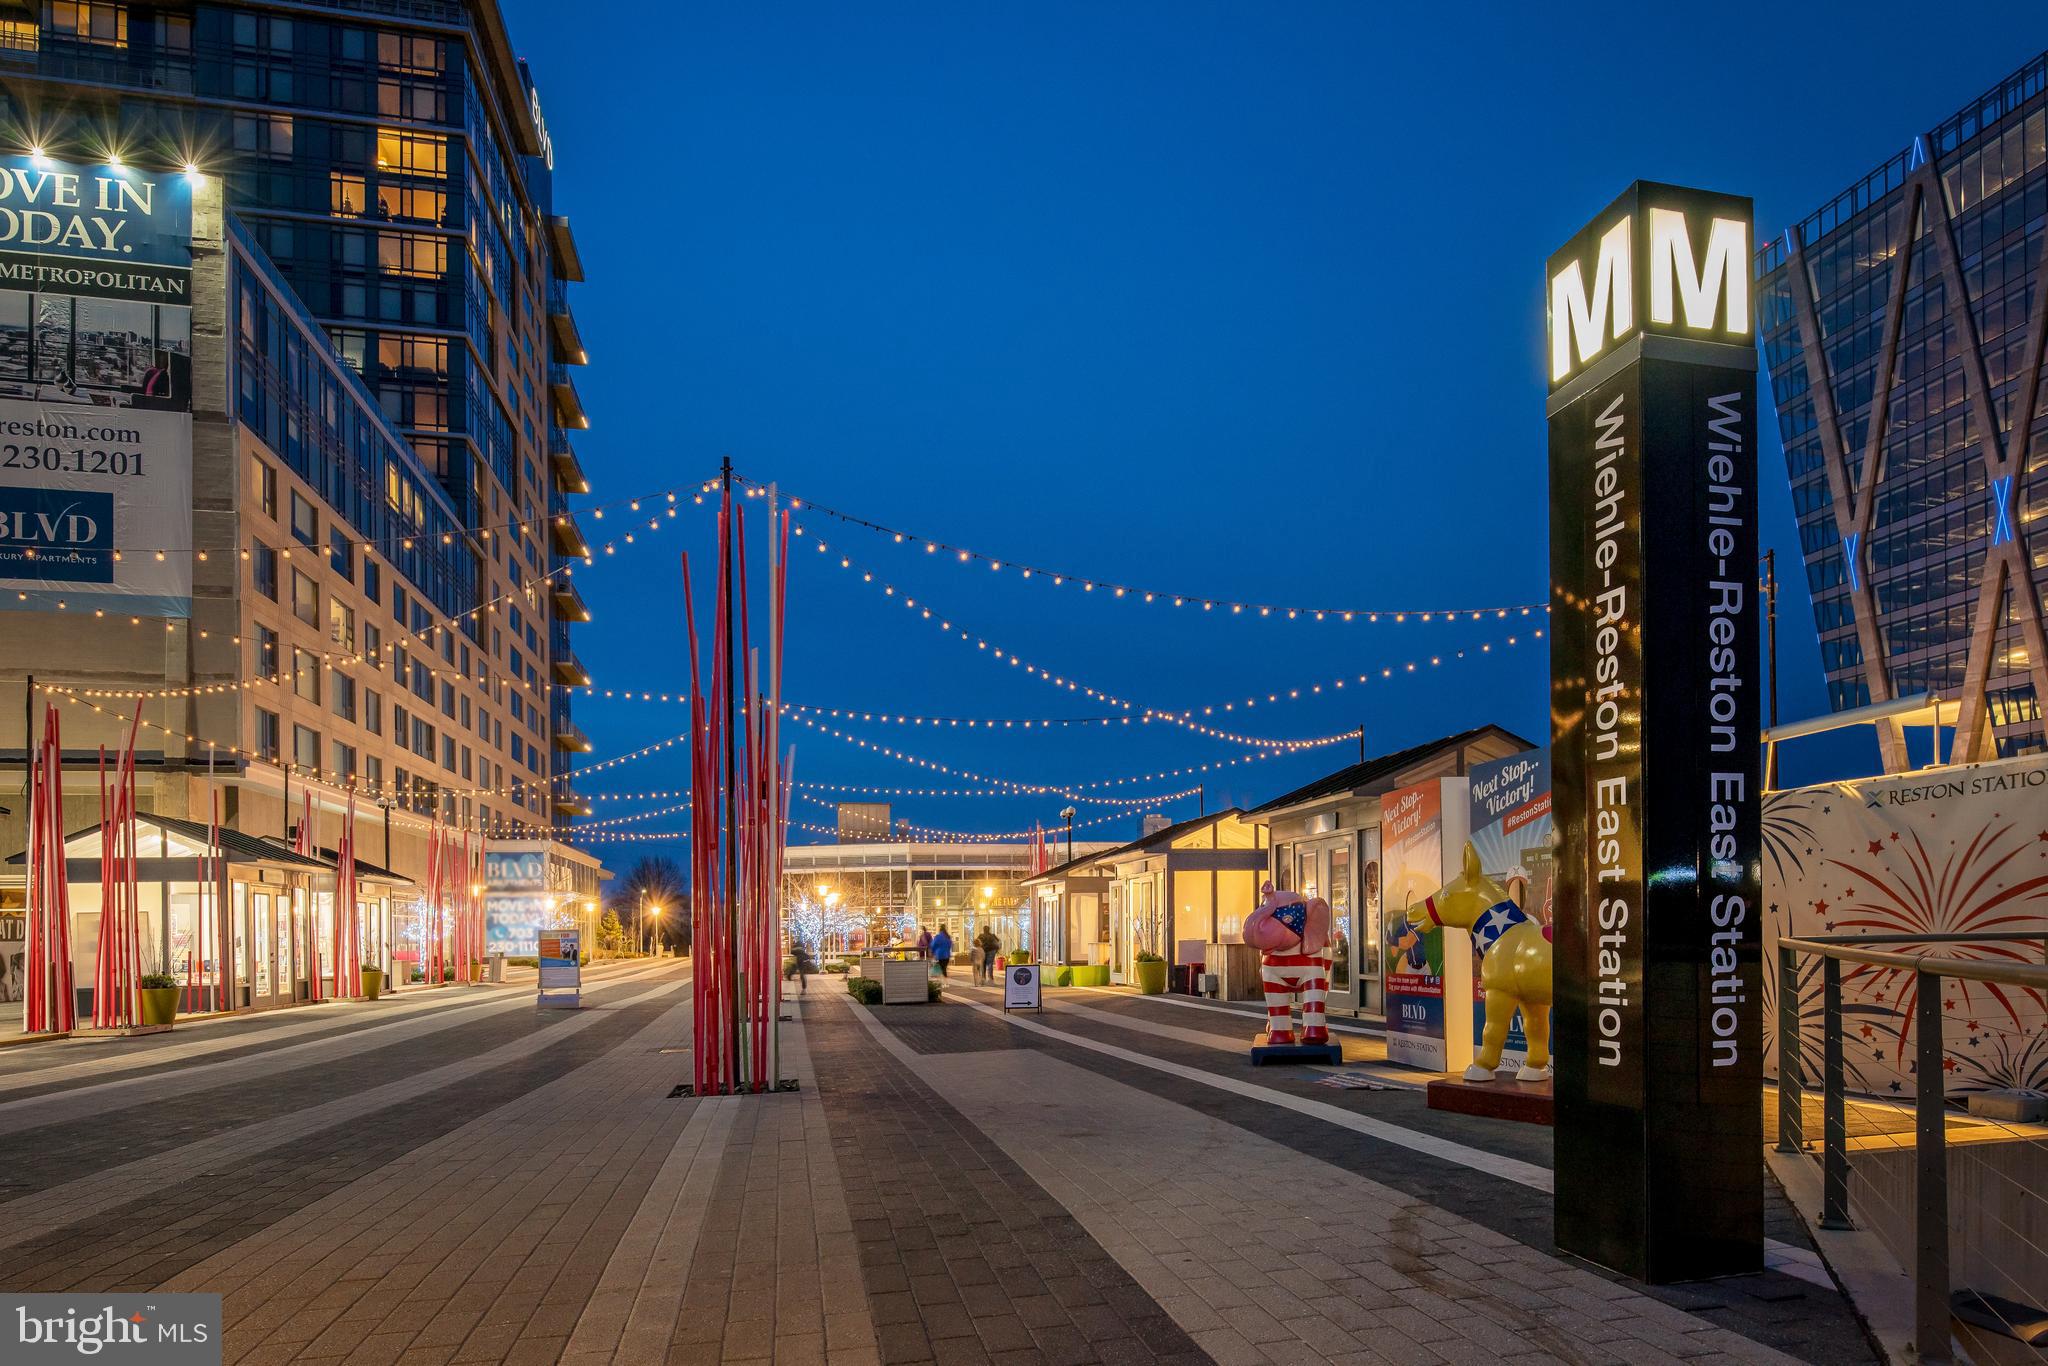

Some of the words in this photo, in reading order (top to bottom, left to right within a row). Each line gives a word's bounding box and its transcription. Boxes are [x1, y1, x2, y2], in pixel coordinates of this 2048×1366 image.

[95, 177, 156, 215] IN
[0, 262, 185, 295] METROPOLITAN
[1650, 207, 1748, 334] M
[1551, 215, 1632, 382] M
[3, 445, 146, 476] 230.1201
[1594, 393, 1626, 760] Wiehle-Reston
[1707, 392, 1743, 752] Wiehle-Reston
[1472, 774, 1498, 803] Next
[1501, 760, 1539, 787] Stop...
[1486, 774, 1534, 816] Victory!
[1889, 781, 1964, 806] RESTON
[1971, 770, 2048, 795] STATIO
[1384, 803, 1399, 825] Next
[1392, 804, 1421, 837] Victory!
[1597, 776, 1627, 882] East
[1710, 772, 1745, 879] East
[488, 862, 542, 878] BLVD
[1598, 898, 1629, 1067] Station
[1710, 895, 1745, 1067] Station
[1402, 1001, 1426, 1020] BLVD
